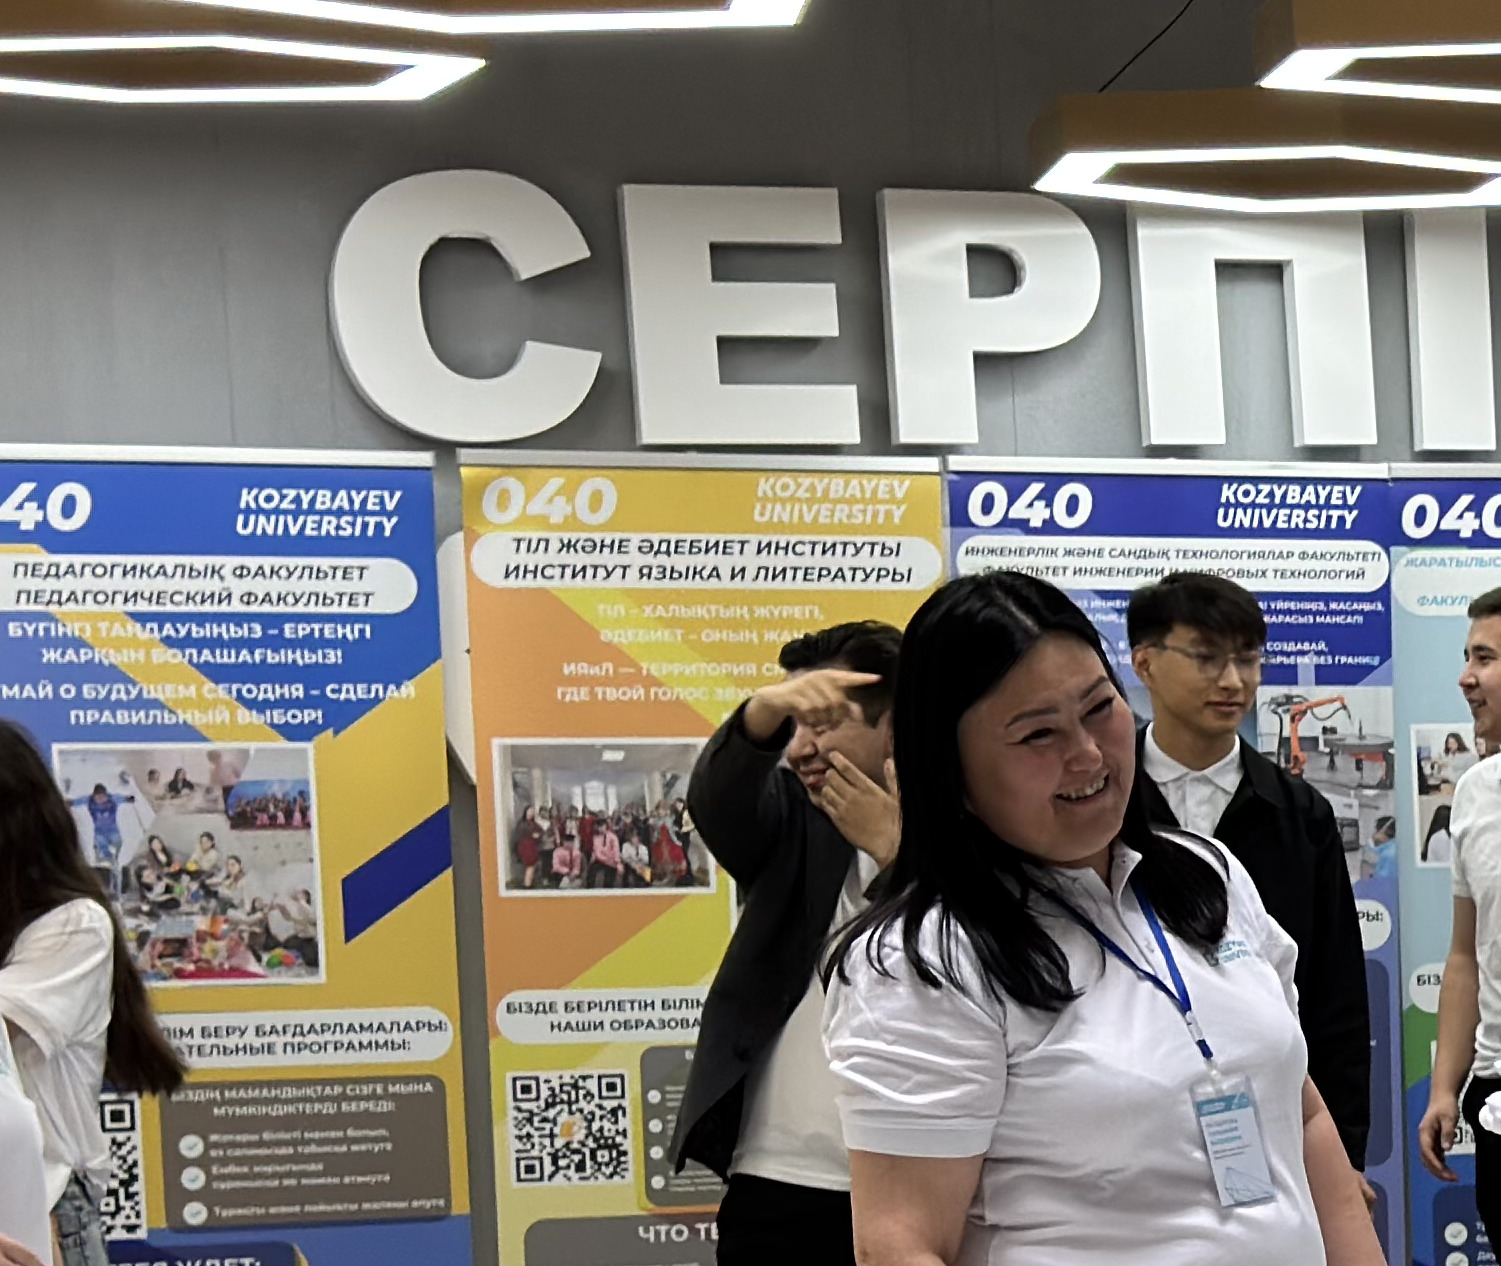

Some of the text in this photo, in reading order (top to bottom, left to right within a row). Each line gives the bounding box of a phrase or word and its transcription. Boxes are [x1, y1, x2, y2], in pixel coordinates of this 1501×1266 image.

[757, 477, 910, 500] KOZYBAYEV
[1220, 483, 1361, 506] KOZYBAYEV
[0, 481, 92, 531] 40
[239, 488, 402, 510] KOZYBAYEV
[482, 477, 618, 525] 040
[968, 481, 1093, 529] 040
[753, 503, 907, 524] UNIVERSITY
[1217, 508, 1358, 530] UNIVERSITY
[236, 515, 397, 536] UNIVERSITY
[512, 538, 901, 557] ТІЛ ЖӘНЕ ӘДЕБИЕТ ИНСТИТУТЫ
[965, 546, 1381, 562] ИНЖЕНЕРЛІК ЖӘНЕ САНДЫҚ ТЕХНОЛОГИЯЛАР ФАКУЛЬТЕТІ
[13, 563, 369, 582] ПЕДАГОГИКАЛЫҚ ФАКУЛЬТЕТ
[504, 563, 912, 584] ИНСТИТУТ ЯЗЫКА И ЛИТЕРАТУРЫ
[1073, 566, 1365, 580] ИНЖЕНЕРИИ ТЕХНОЛОГИЙ
[16, 587, 374, 608] ПЕДАГОГИЧЕСКИЙ ФАКУЛЬТЕТ
[284, 623, 370, 641] ЕРТЕҢГІ
[600, 629, 759, 645] ӘДЕБИЕТ ОНЫҢ
[42, 648, 144, 666] ЖАРҚЫН
[641, 663, 756, 678] ТЕРРИТОРИЯ
[82, 683, 415, 701] БУДУЩЕМ СЕГОДНЯ СДЕЛАЙ
[557, 687, 589, 701] ГДЕ
[595, 685, 644, 701] ТВОЙ
[650, 687, 711, 701] ГОЛОС
[70, 707, 322, 725] ПРАВИЛЬНЫЙ ВЫБОР!
[506, 999, 656, 1016] БІЗДЕ БЕРІЛЕТІН
[200, 1025, 248, 1039] БЕРУ
[550, 1020, 604, 1032] НАШИ
[283, 1039, 411, 1055] ПРОГРАММЫ:
[638, 1223, 689, 1243] ЧТО
